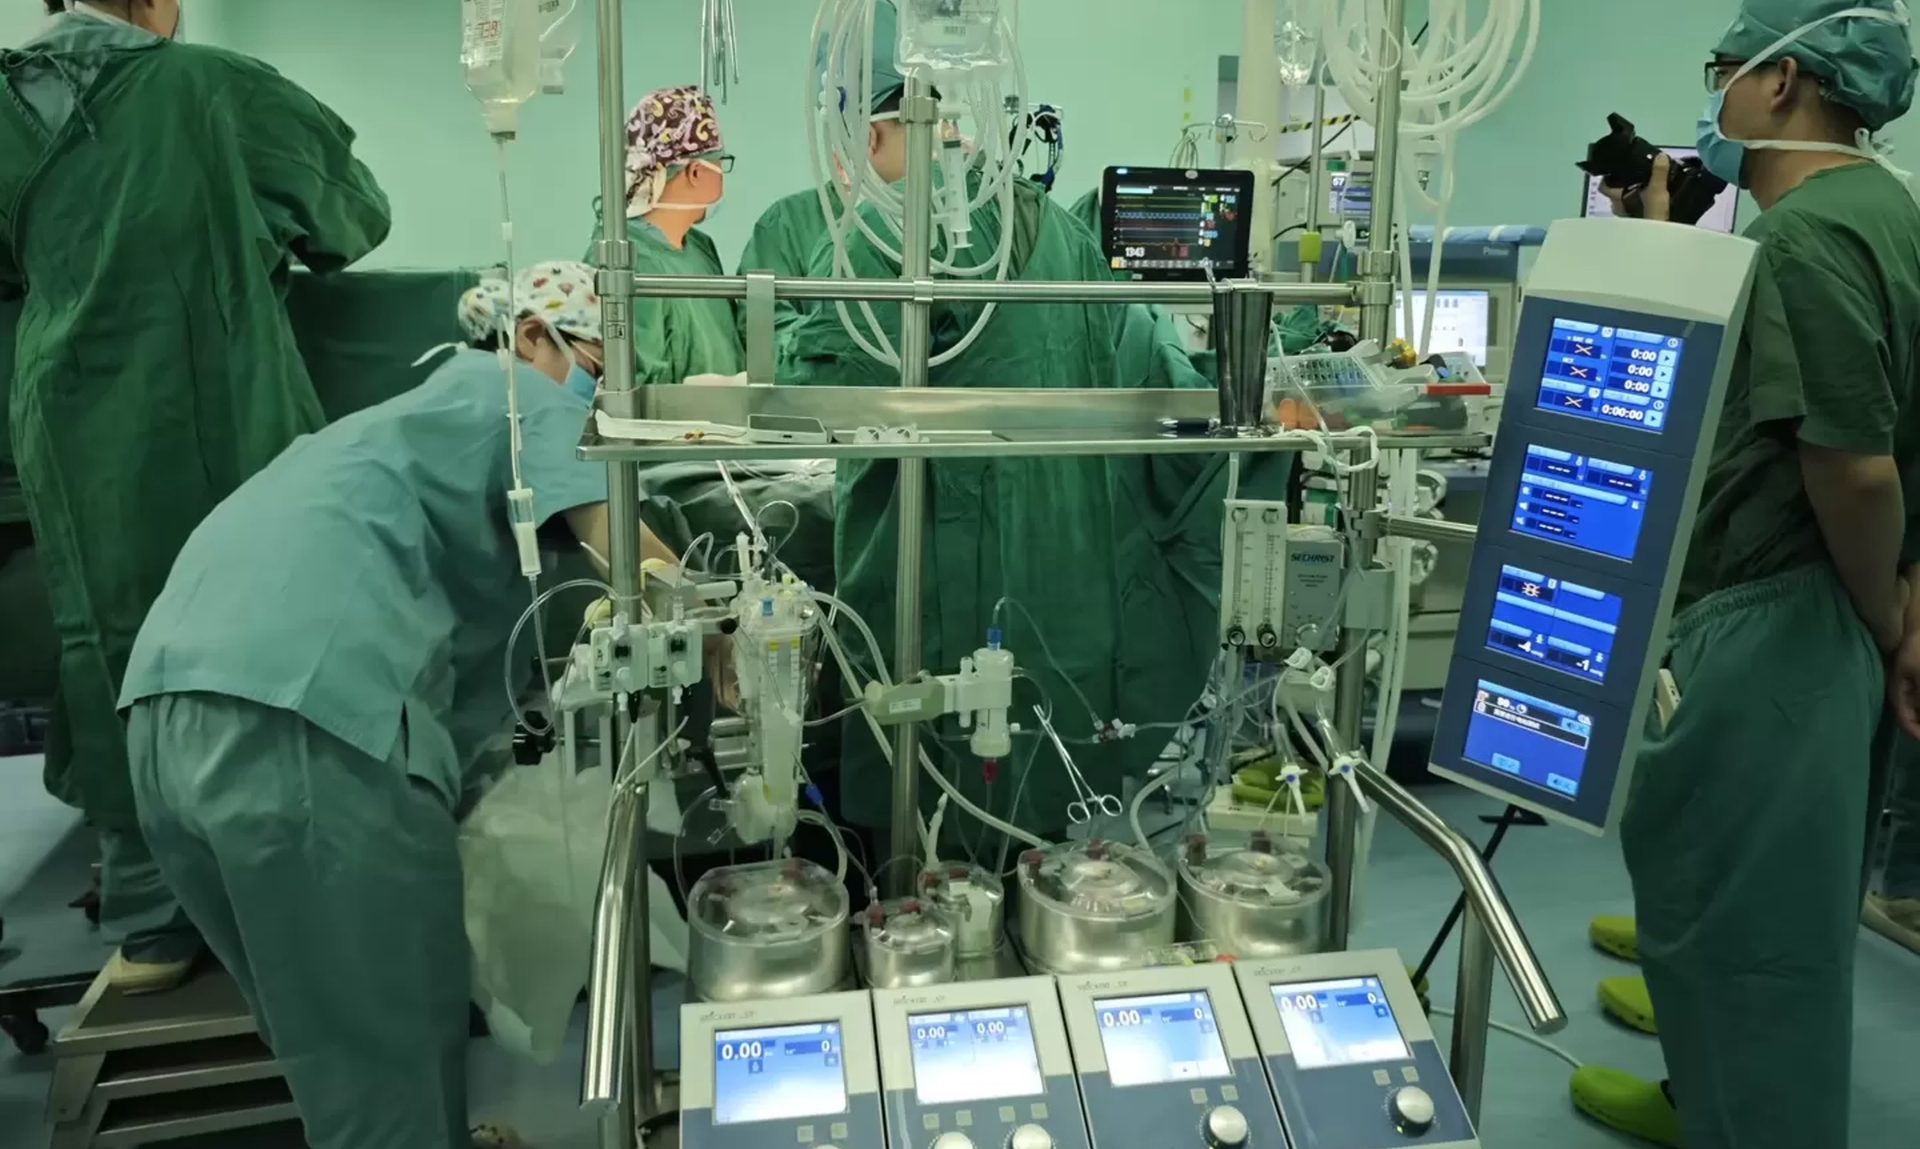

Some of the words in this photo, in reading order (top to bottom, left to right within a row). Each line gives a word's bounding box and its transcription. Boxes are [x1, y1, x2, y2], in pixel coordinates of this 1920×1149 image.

[1631, 348, 1657, 362] 0:00
[1627, 364, 1653, 377] 0:00
[1624, 379, 1650, 393] 0:00
[1601, 404, 1644, 420] 0:00:00
[1290, 553, 1335, 563] SECHRIST
[1576, 659, 1590, 671] -1
[1280, 994, 1318, 1010] 0.00
[1367, 992, 1377, 1004] 0
[1103, 1009, 1141, 1027] 0.00
[1194, 1008, 1203, 1019] 0
[917, 1026, 945, 1039] 0.00
[976, 1021, 1005, 1034] 0.00
[722, 1041, 762, 1060] 0.00
[821, 1040, 831, 1052] 0
